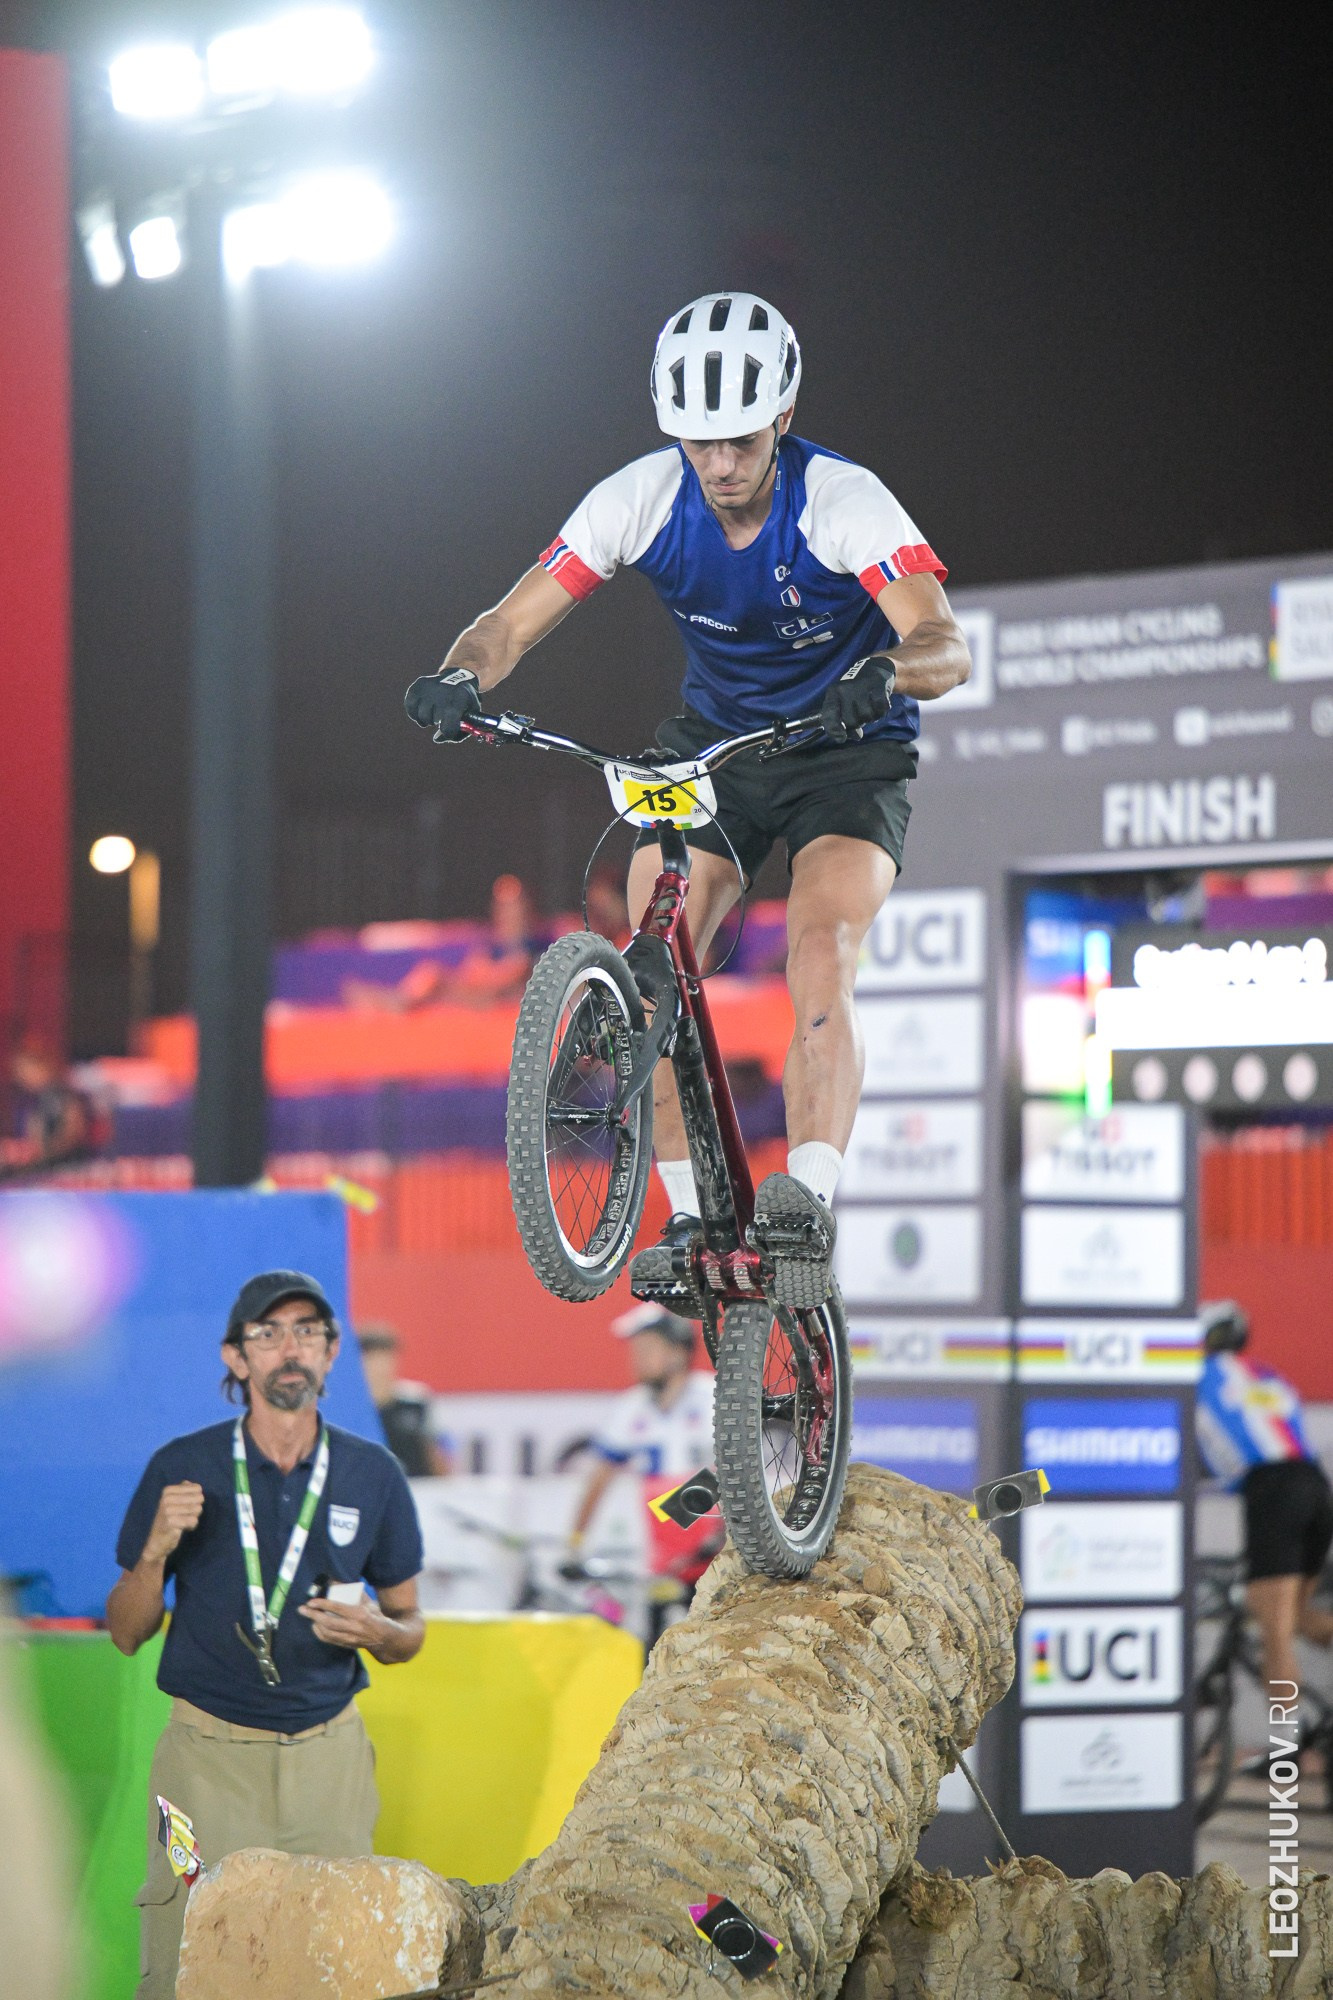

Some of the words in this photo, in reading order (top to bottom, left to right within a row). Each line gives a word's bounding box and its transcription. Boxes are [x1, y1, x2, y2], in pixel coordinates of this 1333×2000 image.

[641, 788, 677, 812] 15
[1104, 775, 1275, 847] FINISH
[869, 911, 965, 967] UCI
[1068, 1332, 1131, 1366] UCI
[1058, 1627, 1158, 1683] UCI
